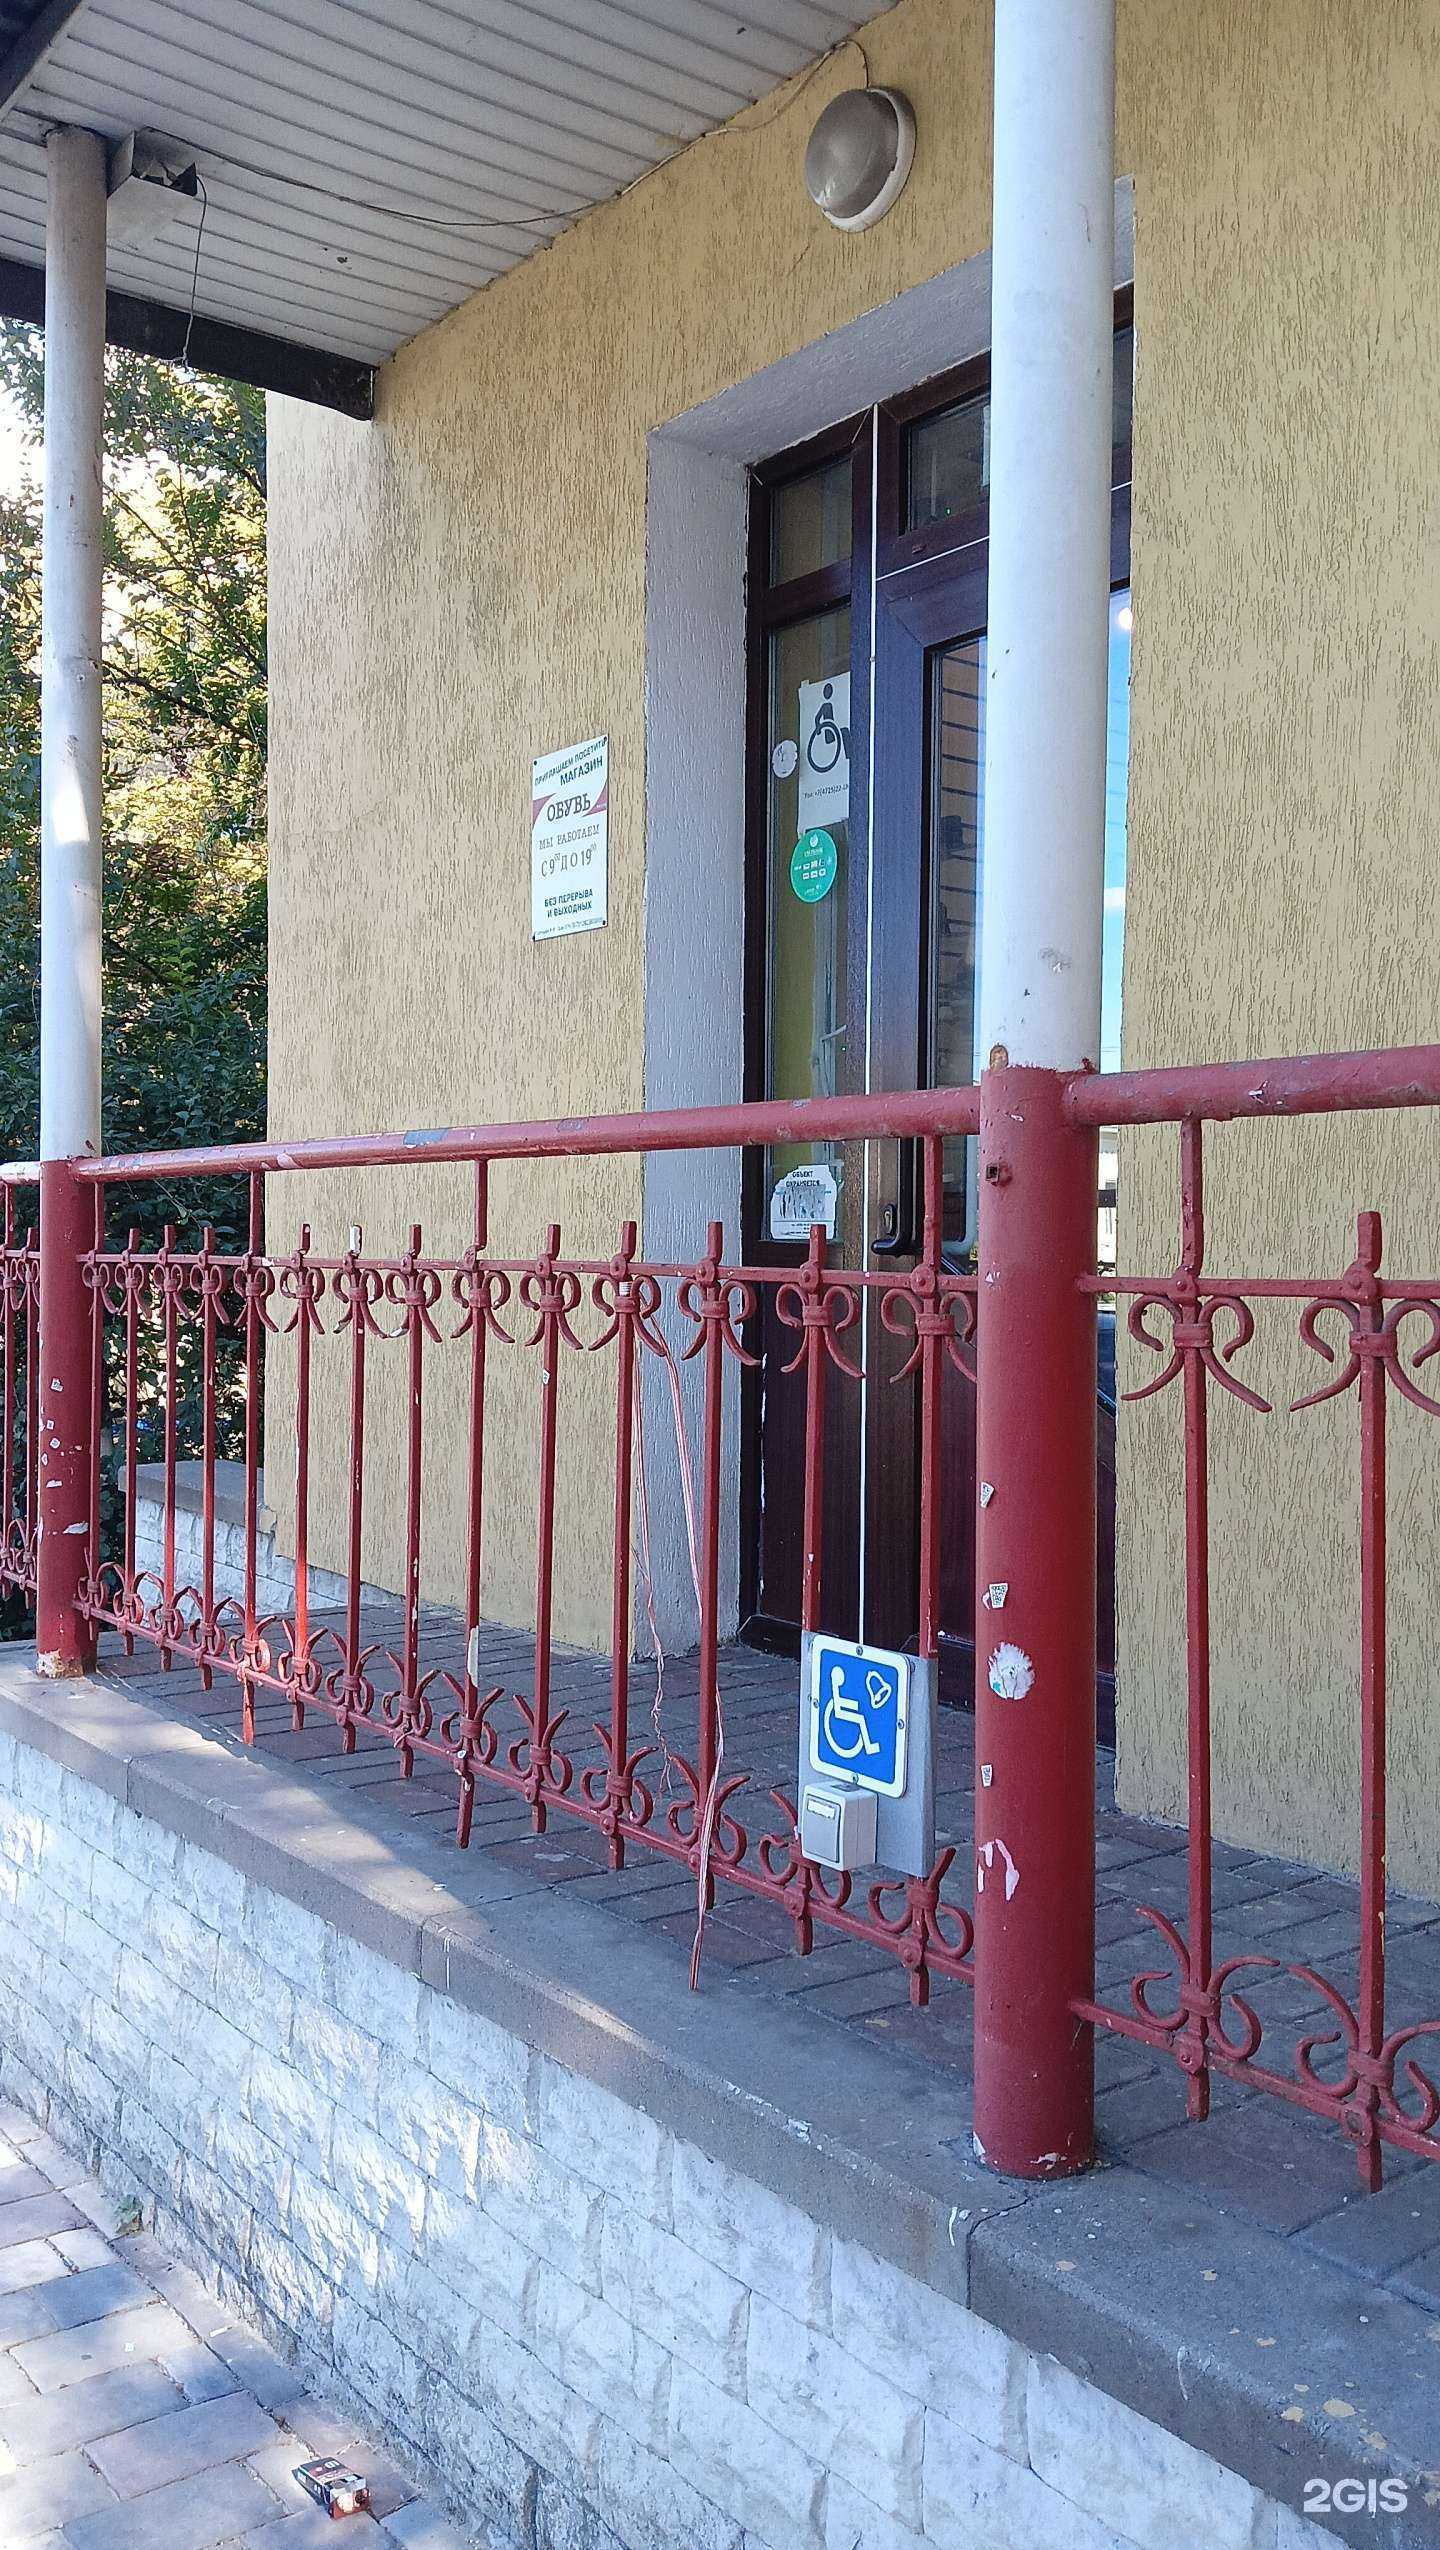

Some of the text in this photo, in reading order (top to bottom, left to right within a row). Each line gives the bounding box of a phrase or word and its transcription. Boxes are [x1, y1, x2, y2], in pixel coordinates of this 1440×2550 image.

[535, 757, 574, 786] ПРИГЛАШАЕМ
[560, 755, 603, 786] МАГАЗИН
[547, 793, 591, 822] ОБУВЬ
[539, 823, 600, 850] МЫ РАБОТАЕМ
[544, 888, 593, 908] БЕЗ ПЕРЕРЫВА
[547, 900, 592, 918] И ВЫХОДНЫХ
